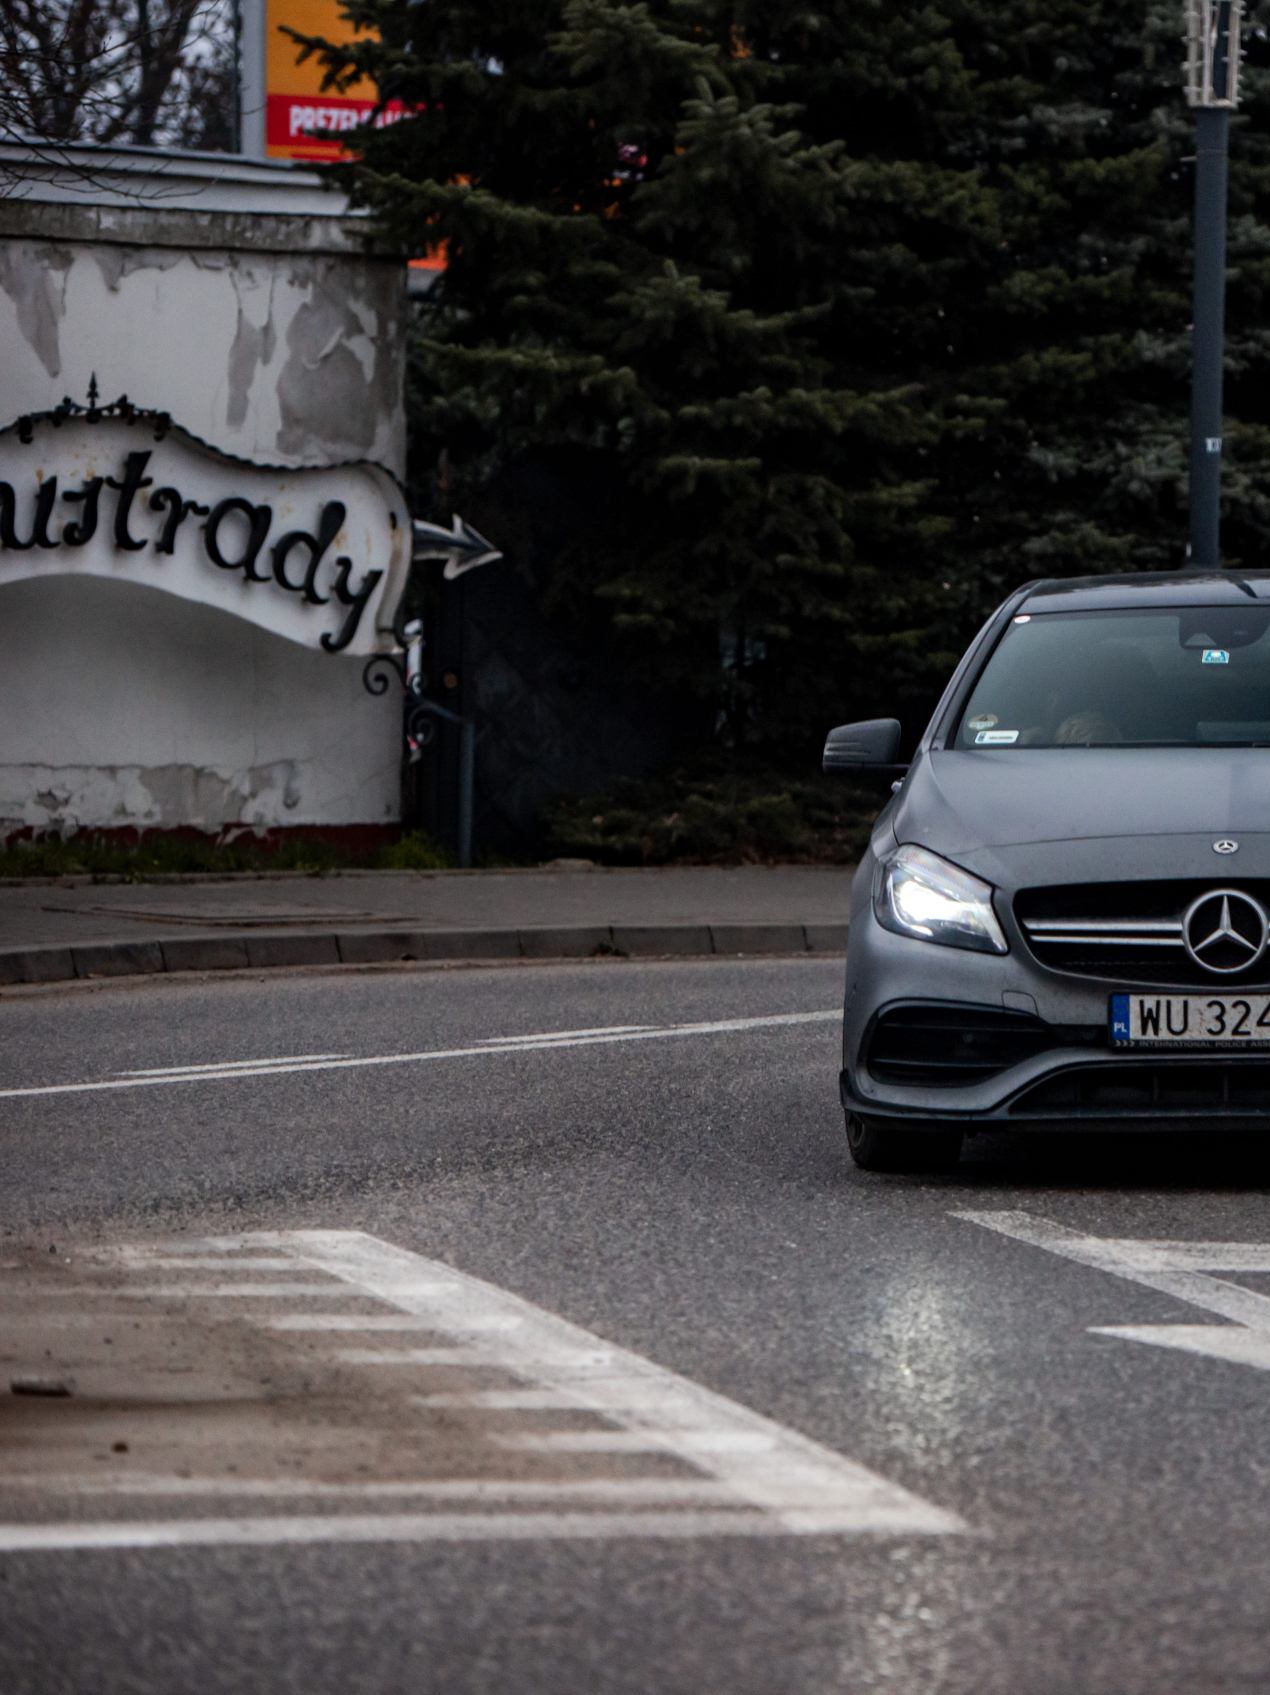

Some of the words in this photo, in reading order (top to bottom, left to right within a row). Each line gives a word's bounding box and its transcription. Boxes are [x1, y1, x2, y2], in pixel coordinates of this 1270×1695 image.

[1139, 999, 1189, 1036] WU
[1114, 1022, 1127, 1033] PL
[1139, 1040, 1211, 1048] INTERNATIONAL
[1215, 1040, 1247, 1048] POLICE
